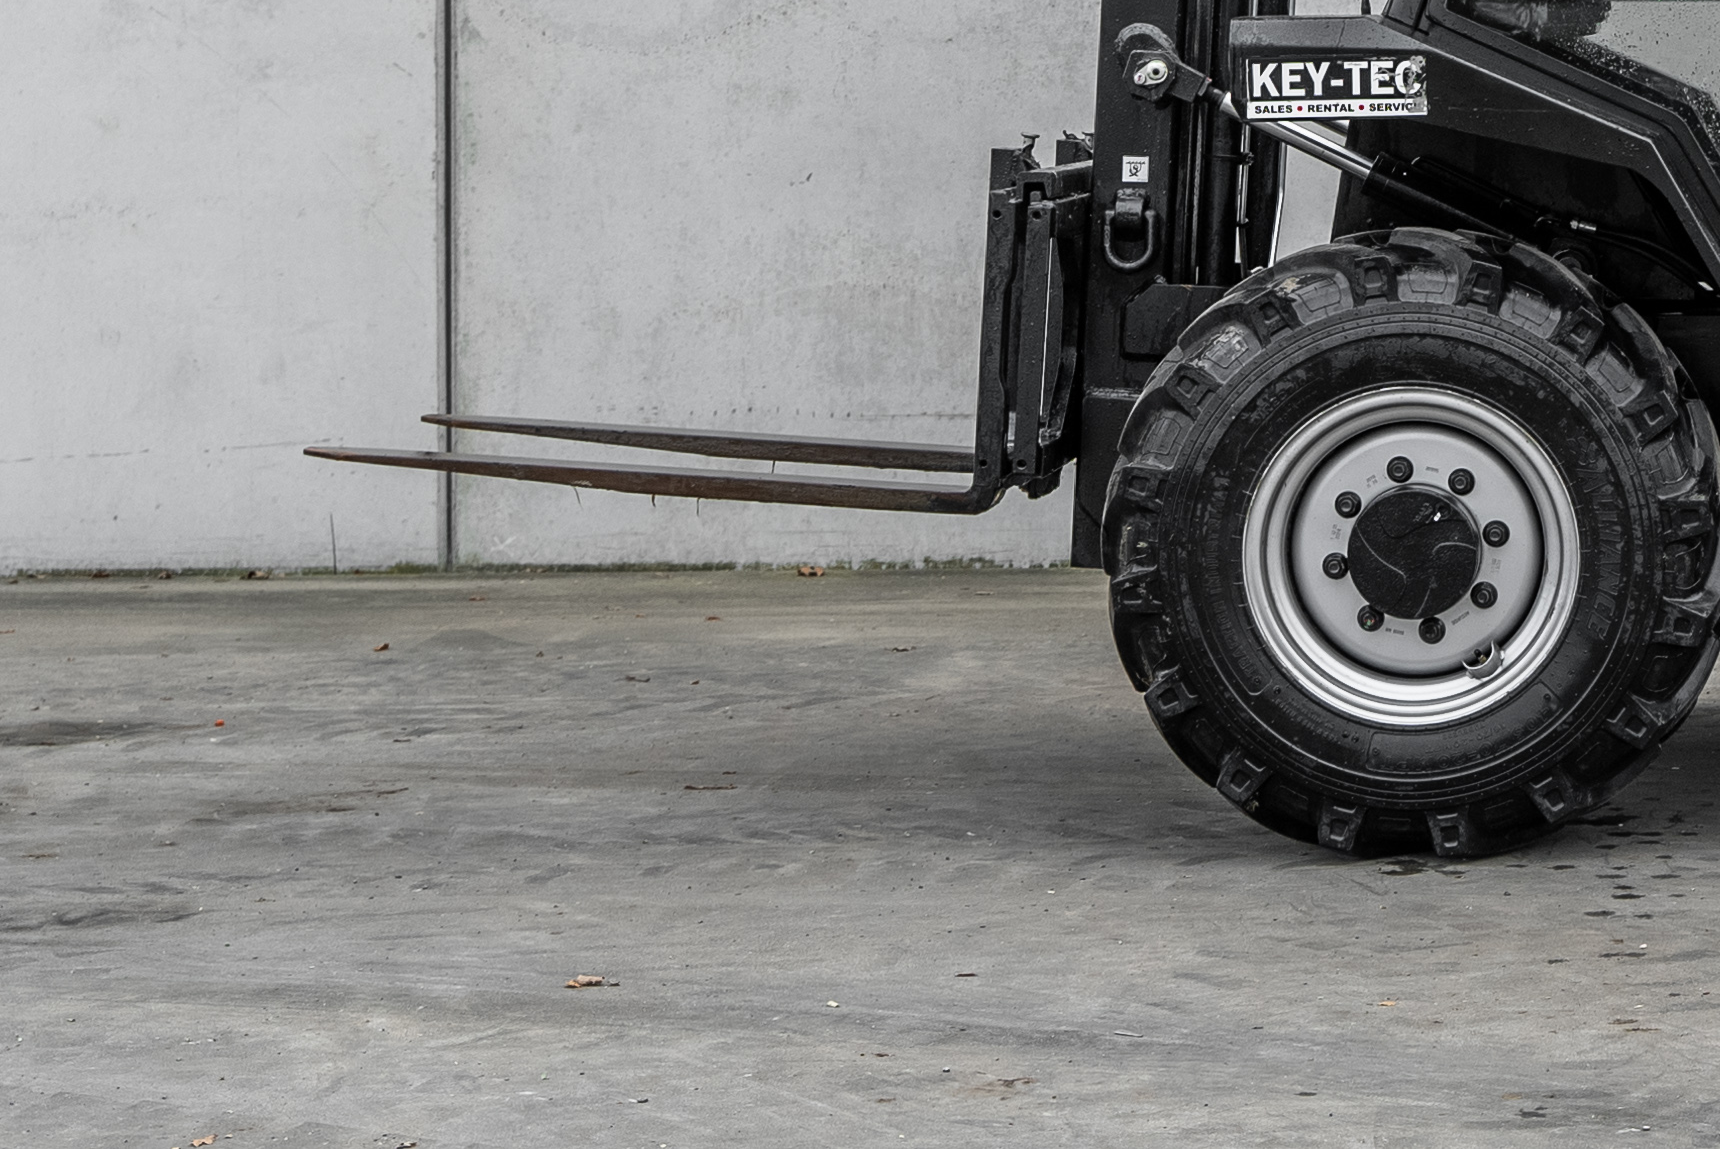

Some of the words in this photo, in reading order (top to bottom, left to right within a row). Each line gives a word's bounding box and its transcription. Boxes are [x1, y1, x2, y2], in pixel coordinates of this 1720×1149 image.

[1252, 60, 1421, 97] KEY-TEC
[1254, 104, 1293, 114] SALES
[1307, 103, 1355, 113] RENTAL
[1369, 102, 1417, 112] SERVIC
